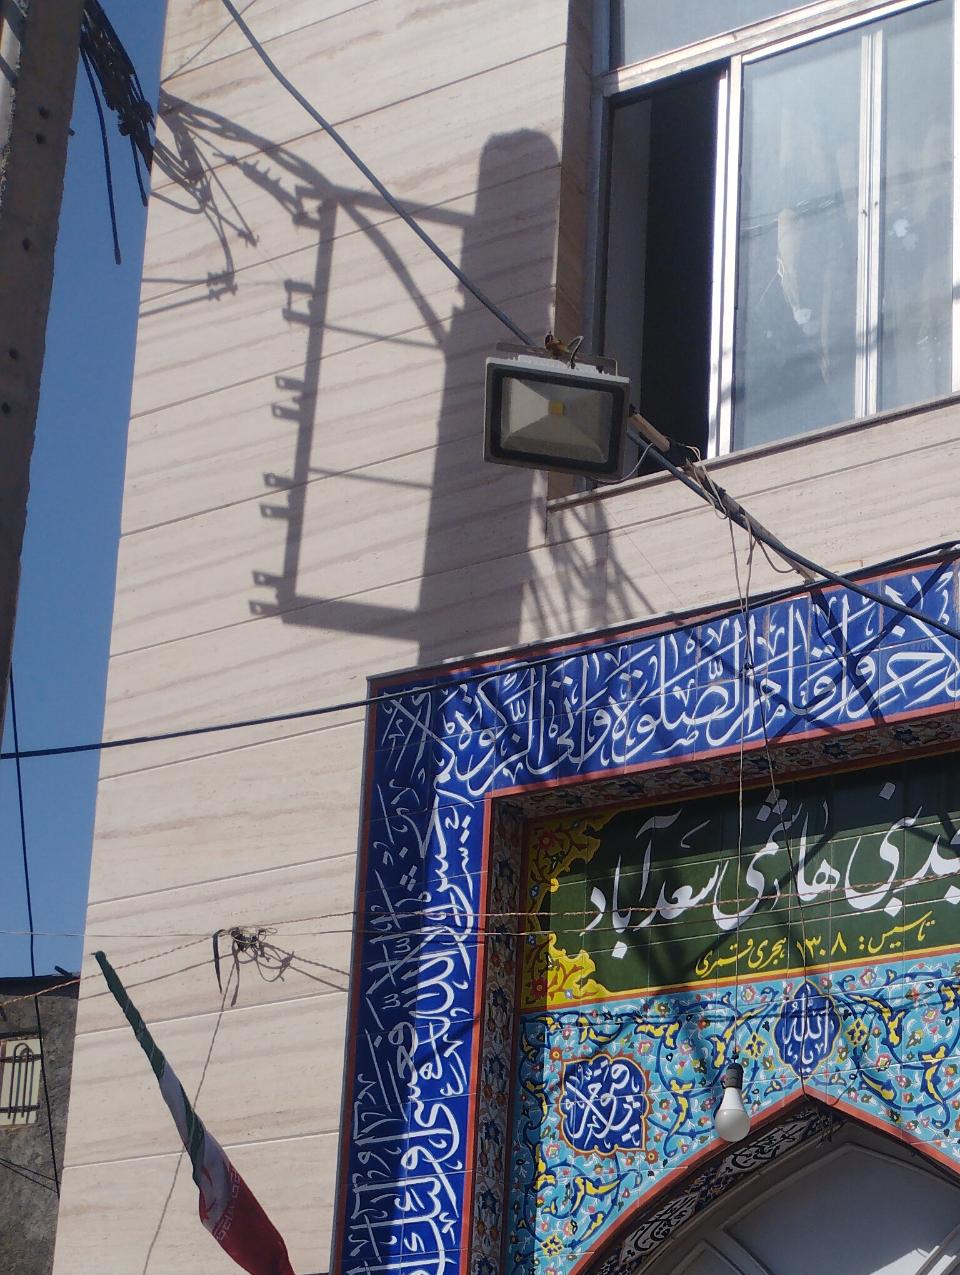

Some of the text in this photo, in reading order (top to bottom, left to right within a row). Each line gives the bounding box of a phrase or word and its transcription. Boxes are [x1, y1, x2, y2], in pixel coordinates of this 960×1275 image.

[714, 789, 842, 932] هاشمی
[846, 782, 922, 917] بنی
[694, 938, 754, 977] قمری
[747, 935, 787, 970] هجری
[369, 951, 463, 1042] الله
[783, 1000, 830, 1053] الله
